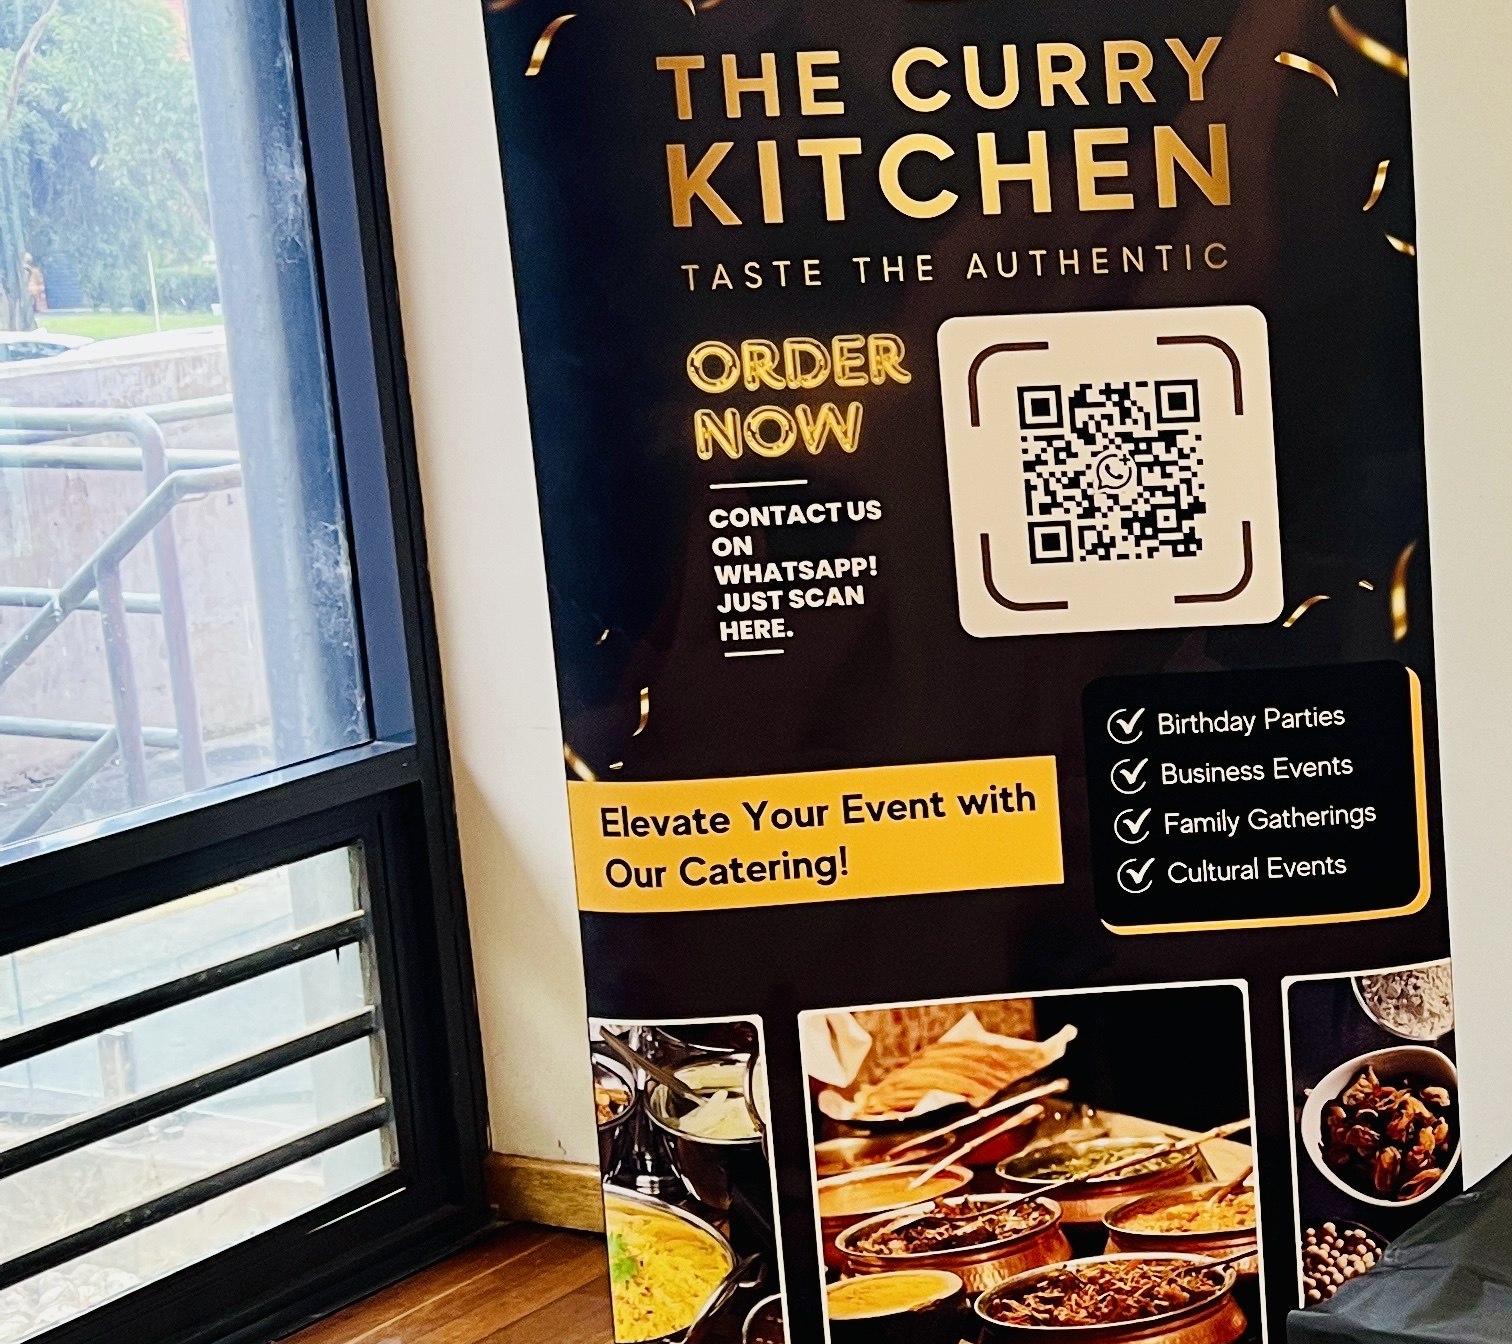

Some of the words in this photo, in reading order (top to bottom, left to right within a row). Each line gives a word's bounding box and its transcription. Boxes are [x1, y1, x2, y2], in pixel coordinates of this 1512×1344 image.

[655, 50, 845, 120] THE
[891, 36, 1223, 113] CURRY
[666, 123, 1231, 228] KITCHEN
[680, 259, 822, 291] TASTE
[851, 254, 933, 284] THE
[966, 242, 1228, 280] AUTHENTIC
[686, 333, 912, 394] ORDER
[693, 401, 864, 461] NOW
[708, 501, 842, 529] CONTACT
[846, 499, 882, 522] US
[711, 535, 753, 557] ON
[713, 555, 878, 585] WHATSAPP!
[716, 589, 784, 614] JUST
[788, 584, 865, 609] SCAN
[719, 617, 794, 642] HERE.
[1158, 709, 1257, 737] Birthday
[1264, 706, 1346, 730] Parties
[1161, 762, 1265, 785] Business
[1272, 756, 1354, 780] Events
[600, 805, 731, 838] Elevate
[741, 800, 829, 831] Your
[842, 791, 946, 825] Event
[956, 782, 1036, 816] with
[1164, 808, 1241, 838] Family
[1247, 805, 1377, 830] Gatherings
[605, 858, 667, 889] Our
[679, 845, 848, 887] Catering!
[1167, 856, 1259, 884] Cultural
[1267, 856, 1348, 879] Events
